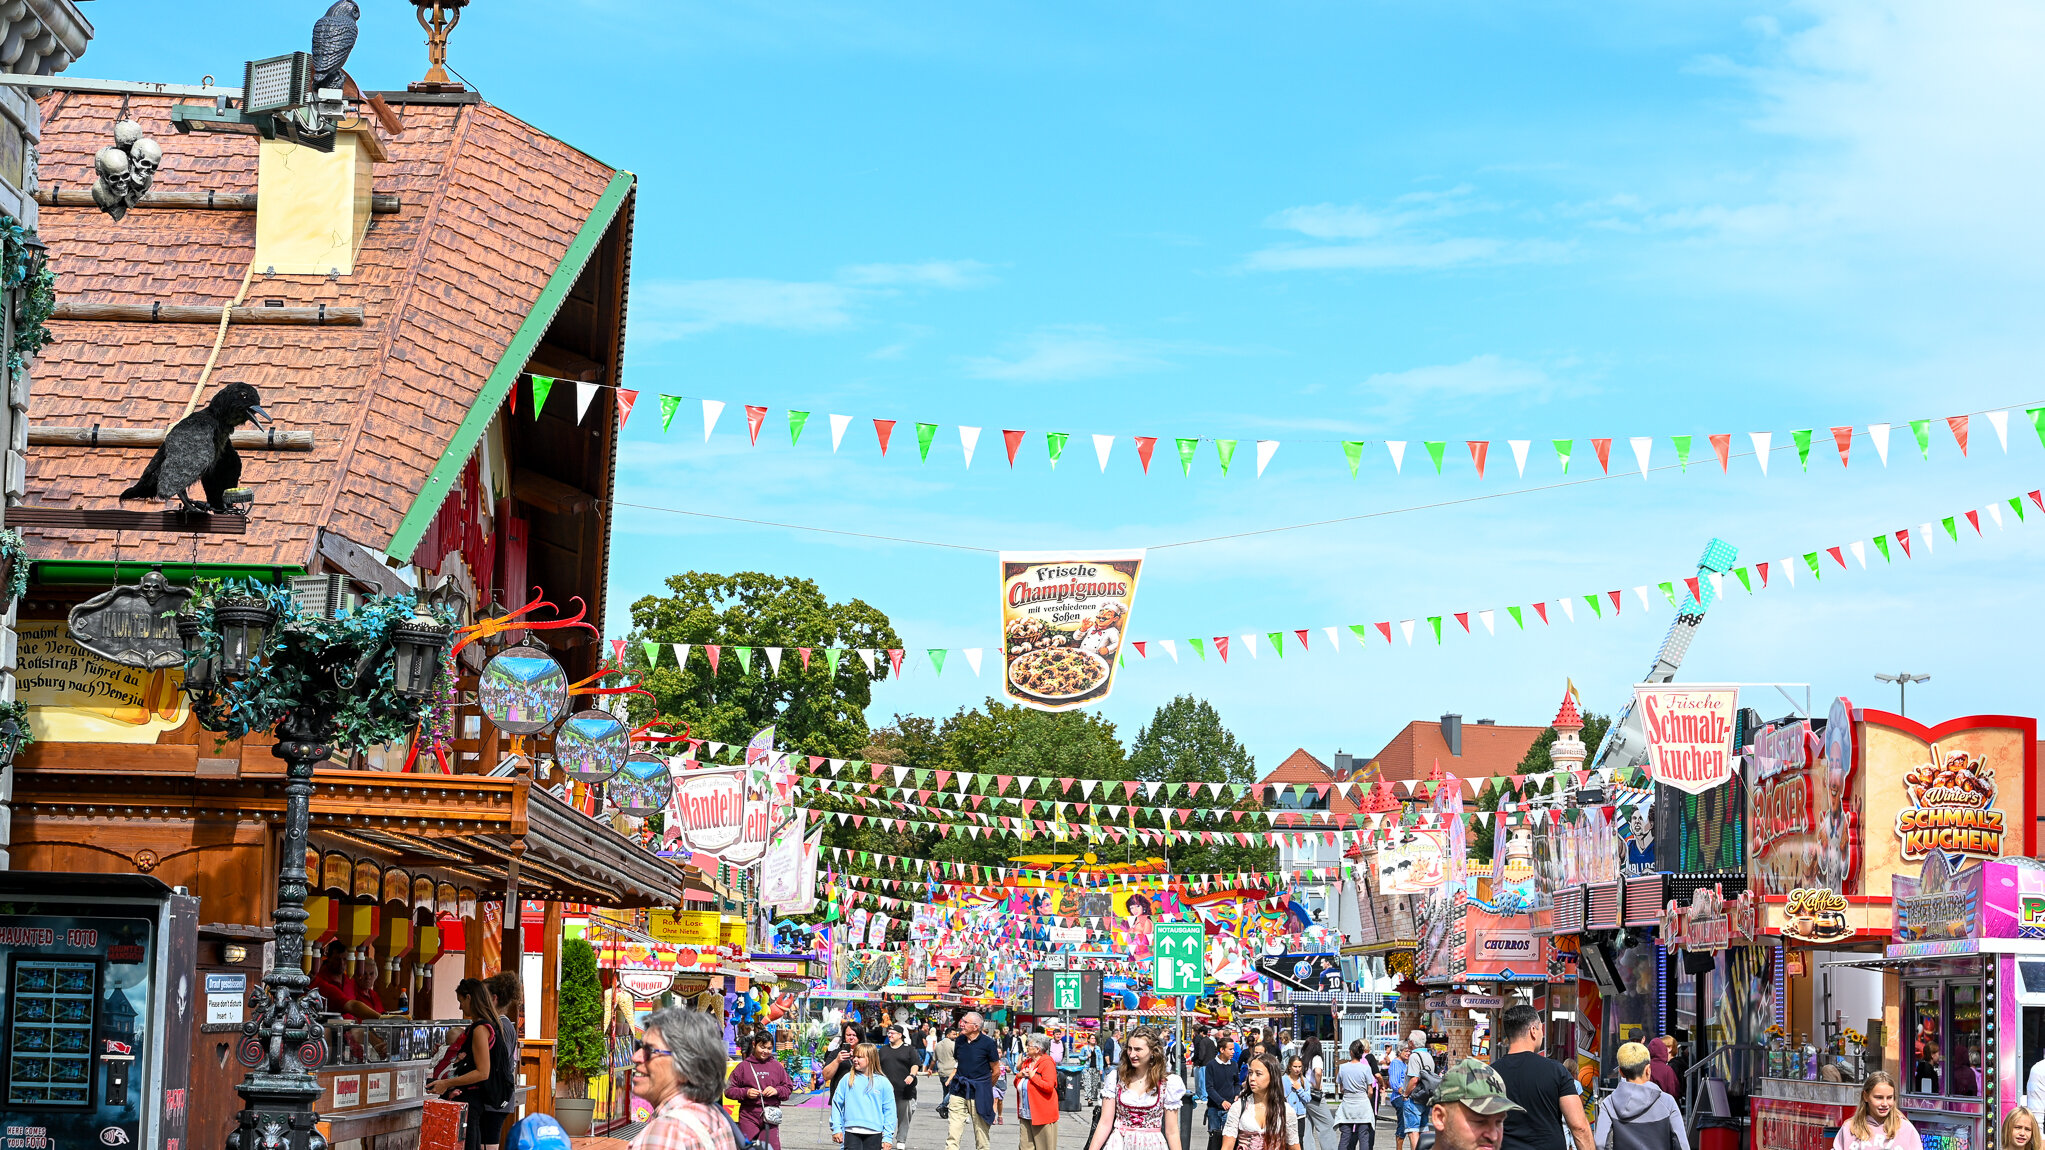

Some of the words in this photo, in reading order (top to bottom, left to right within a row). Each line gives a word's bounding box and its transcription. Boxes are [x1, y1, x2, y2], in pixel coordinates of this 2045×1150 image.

[1036, 565, 1097, 582] Frische
[1008, 578, 1127, 608] Champignons
[1028, 606, 1041, 615] mit
[1043, 603, 1097, 613] verschiedenen
[102, 612, 150, 638] HAUNTED
[1051, 612, 1080, 624] Soßen
[123, 672, 139, 687] da
[15, 673, 66, 692] ugsburg
[68, 679, 96, 697] nach
[97, 680, 145, 708] Venezia
[1664, 693, 1724, 710] Frische
[1645, 695, 1731, 745] Schmalz-
[1754, 721, 1805, 786] MEISTER
[1659, 745, 1724, 781] kuchen
[1926, 787, 1979, 804] Winter's
[677, 787, 742, 831] Mandeln
[1753, 775, 1808, 847] BÄCKER
[1900, 808, 2003, 831] SCHMALZ
[1906, 829, 1999, 854] KUCHEN
[1786, 889, 1848, 914] Kaffee
[685, 919, 703, 927] Lose
[67, 929, 98, 948] FOTO
[1484, 939, 1530, 951] CHURROS
[107, 945, 145, 954] HAUNTED
[209, 978, 221, 988] Drauf
[631, 979, 663, 991] Popcorn
[1329, 977, 1341, 988] 10
[7, 1126, 24, 1135] HERE
[25, 1126, 46, 1136] COMES
[7, 1138, 24, 1148] YOUR
[25, 1137, 47, 1149] FOTO
